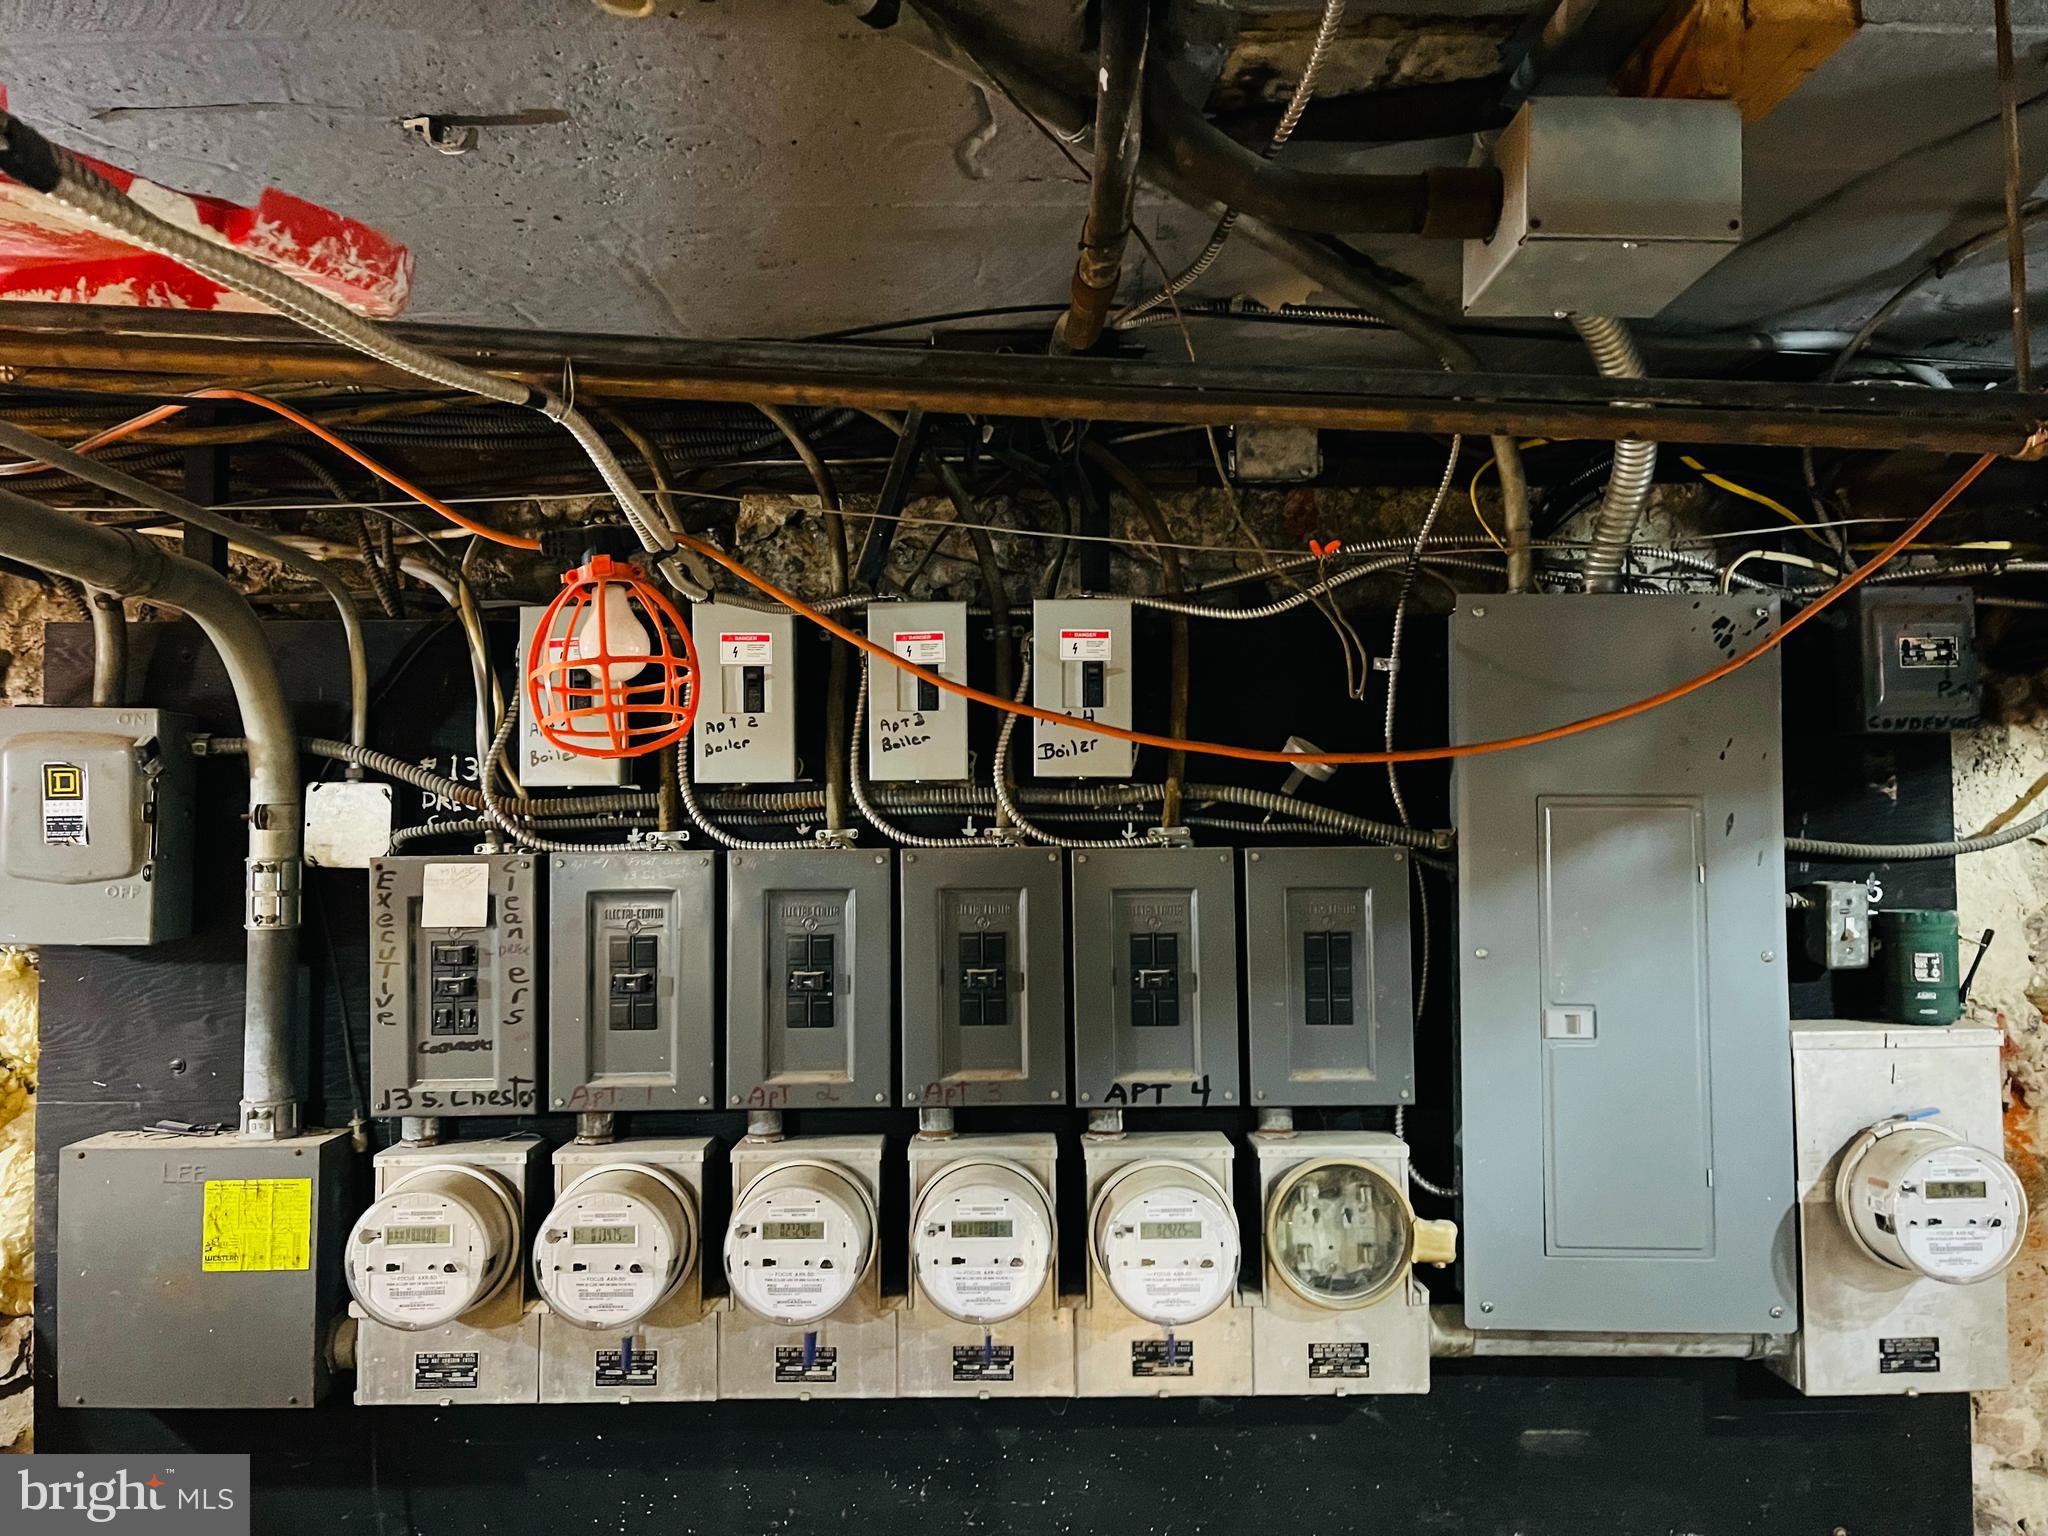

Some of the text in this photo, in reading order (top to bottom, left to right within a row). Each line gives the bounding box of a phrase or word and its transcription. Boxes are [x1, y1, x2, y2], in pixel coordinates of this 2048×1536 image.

[117, 712, 148, 728] ON
[747, 717, 758, 728] 2
[1038, 739, 1098, 760] Boiler
[448, 754, 480, 782] 13
[105, 884, 142, 900] OFF
[1104, 1074, 1212, 1108] APT 4
